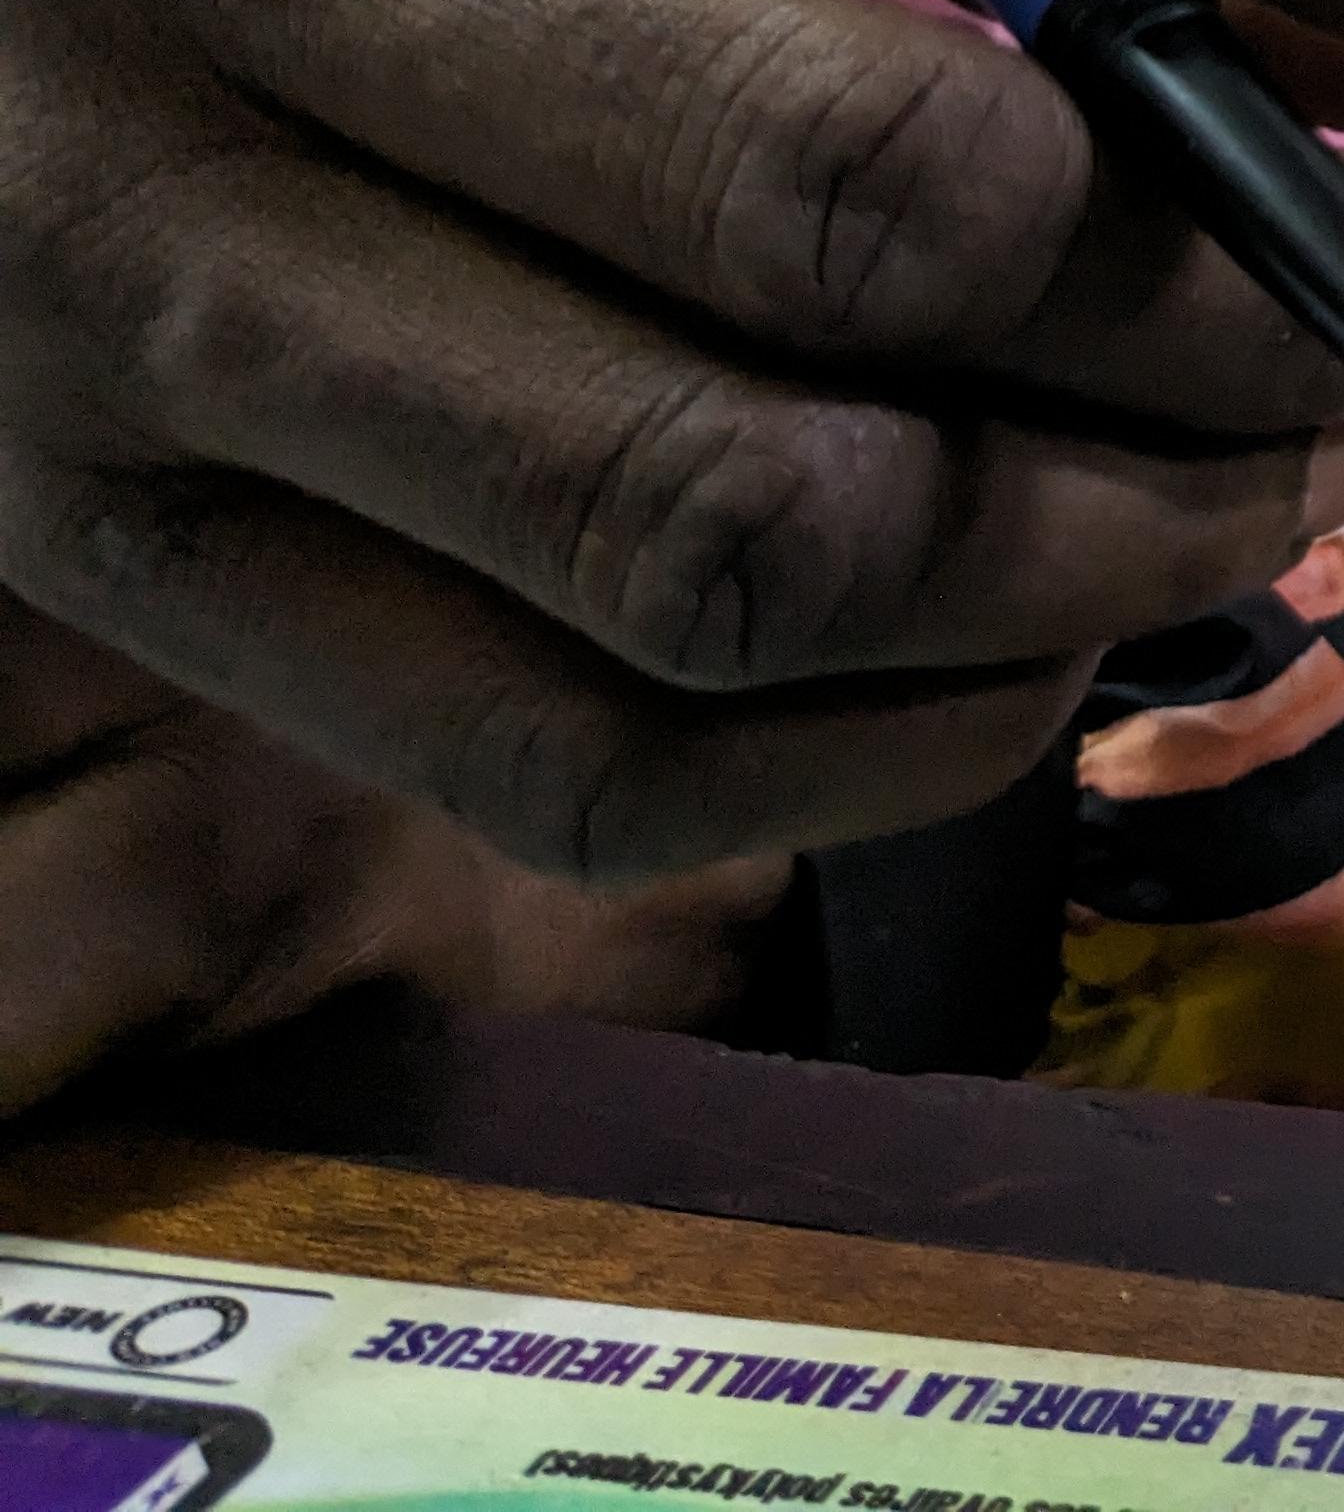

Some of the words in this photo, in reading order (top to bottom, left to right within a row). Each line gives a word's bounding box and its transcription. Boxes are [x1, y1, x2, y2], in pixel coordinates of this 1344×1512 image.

[352, 1318, 659, 1386] HEUREUSE
[642, 1347, 909, 1413] FAMILLE
[904, 1372, 998, 1422] LA
[984, 1380, 1234, 1445] RENDRE
